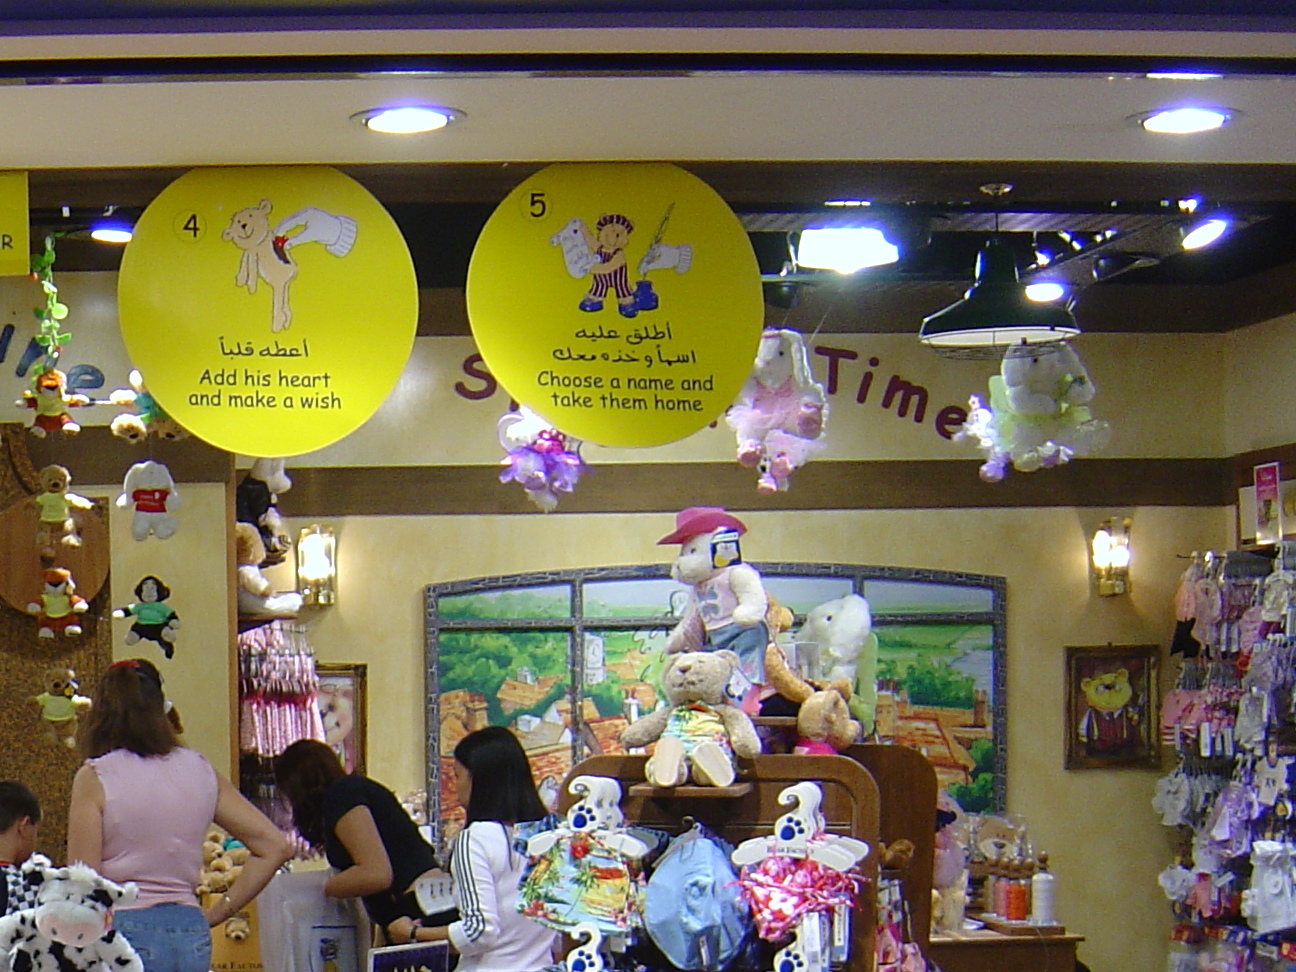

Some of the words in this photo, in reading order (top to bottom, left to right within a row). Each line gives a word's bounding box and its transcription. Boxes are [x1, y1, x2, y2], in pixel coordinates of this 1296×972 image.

[529, 192, 546, 218] 5
[183, 213, 200, 238] 4
[199, 368, 237, 386] Add
[244, 369, 271, 387] his
[278, 369, 331, 388] heart
[537, 370, 604, 389] Choose
[610, 376, 621, 389] a
[627, 377, 675, 391] name
[681, 375, 714, 392] and
[189, 389, 221, 407] and
[228, 390, 277, 408] make
[283, 396, 293, 408] a
[300, 391, 341, 410] wish
[551, 390, 594, 408] take
[600, 391, 648, 410] them
[654, 393, 704, 412] home
